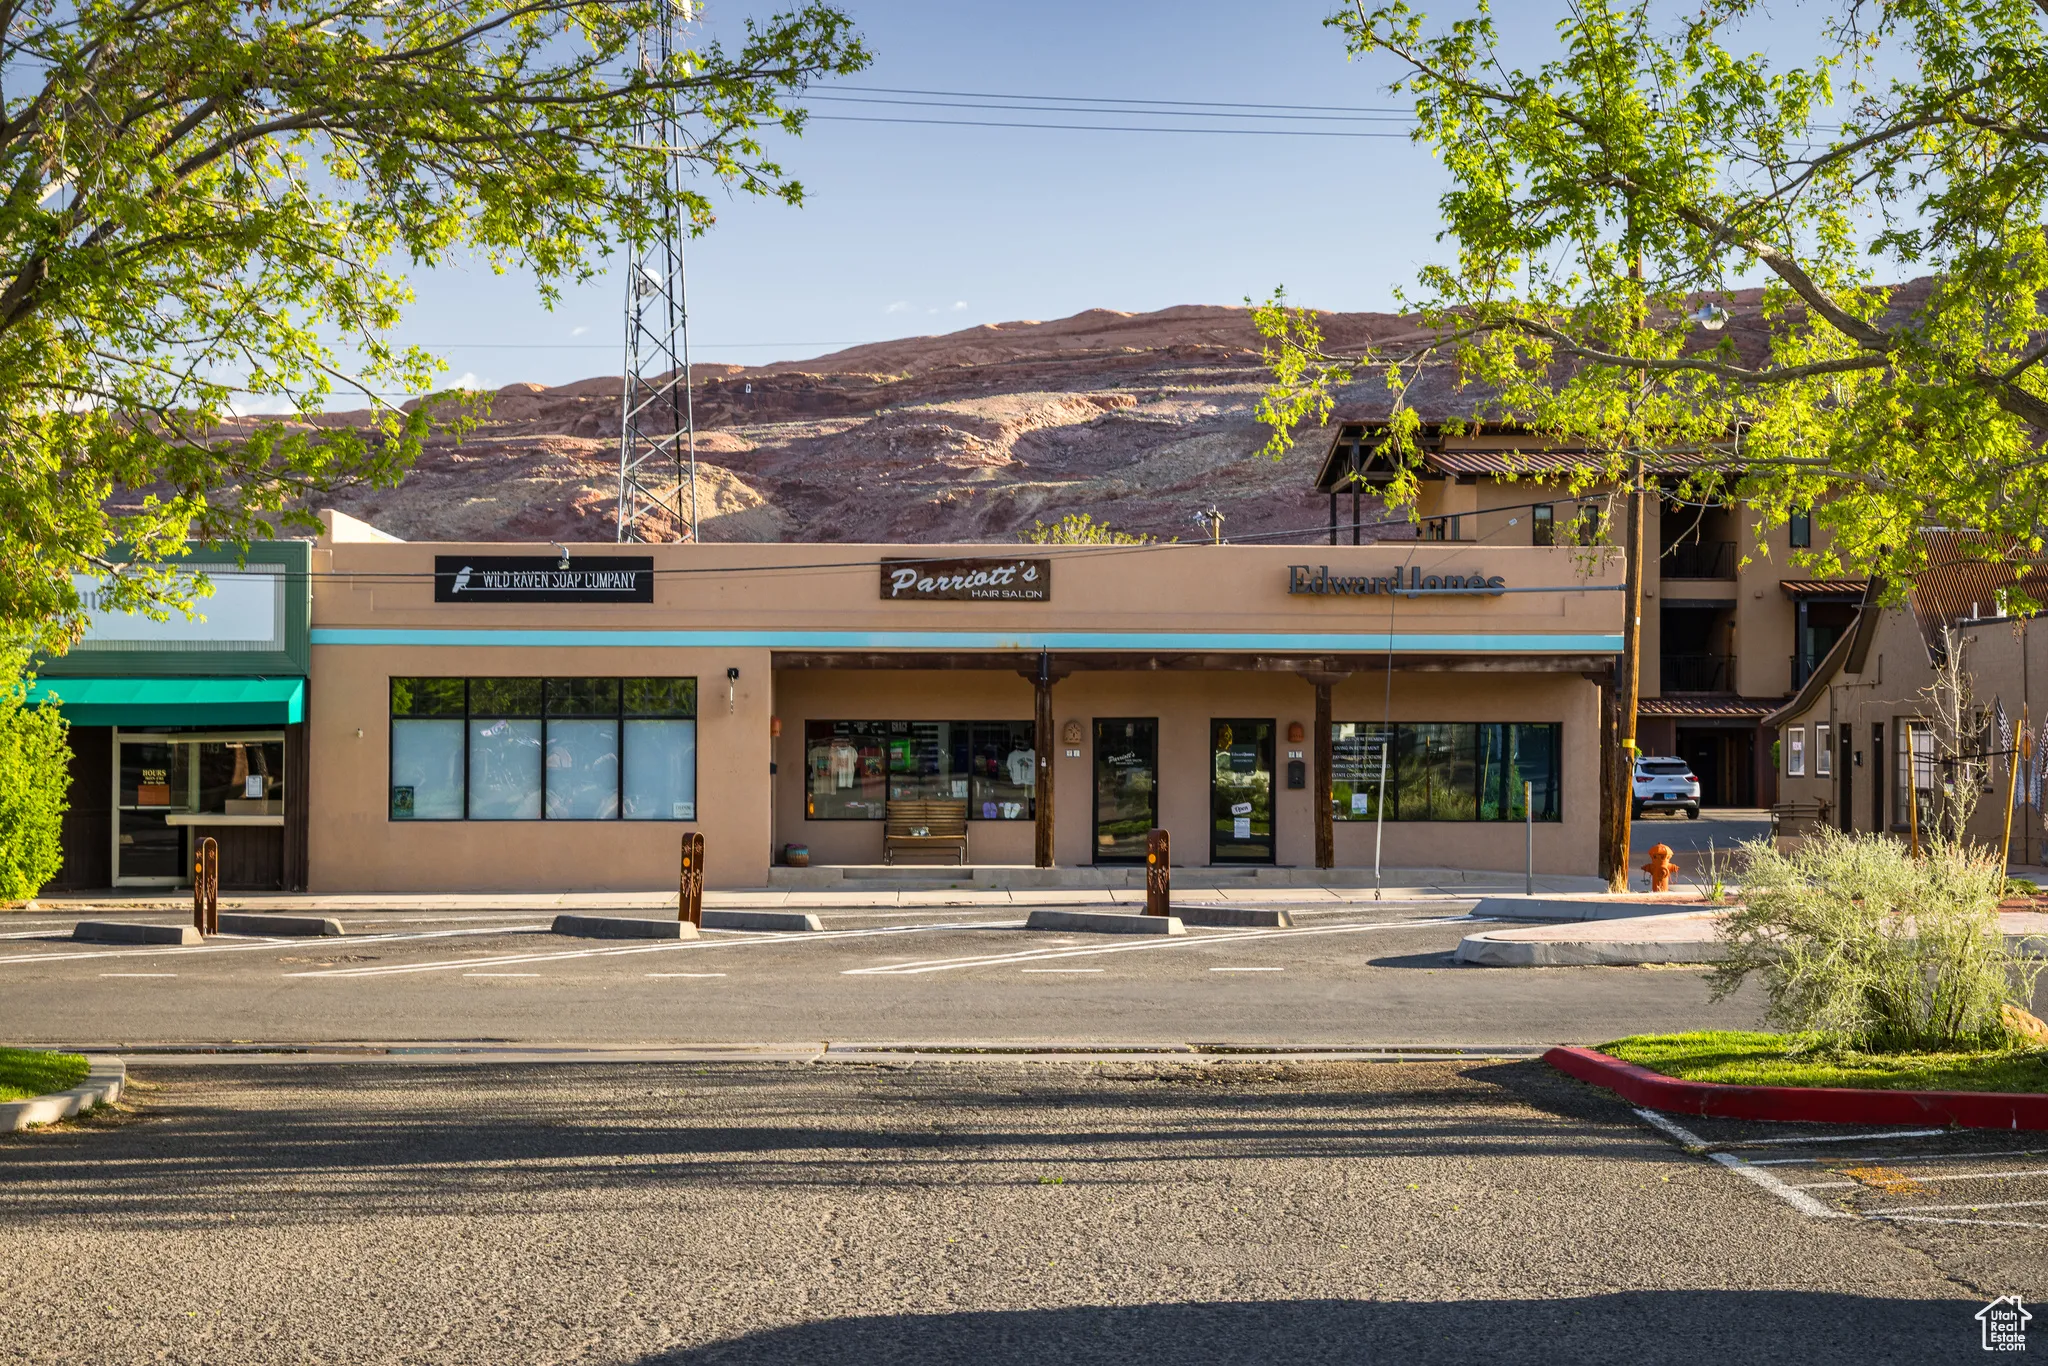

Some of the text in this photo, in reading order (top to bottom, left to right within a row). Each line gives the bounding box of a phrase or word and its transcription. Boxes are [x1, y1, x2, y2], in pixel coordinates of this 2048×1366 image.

[482, 571, 636, 588] WILD RAVEN SOAP COMPANY
[890, 561, 1039, 597] Parriott's
[1287, 565, 1404, 595] Edward
[972, 589, 1043, 598] HAIR SALON
[142, 769, 167, 777] HOURS
[1234, 805, 1249, 813] Open
